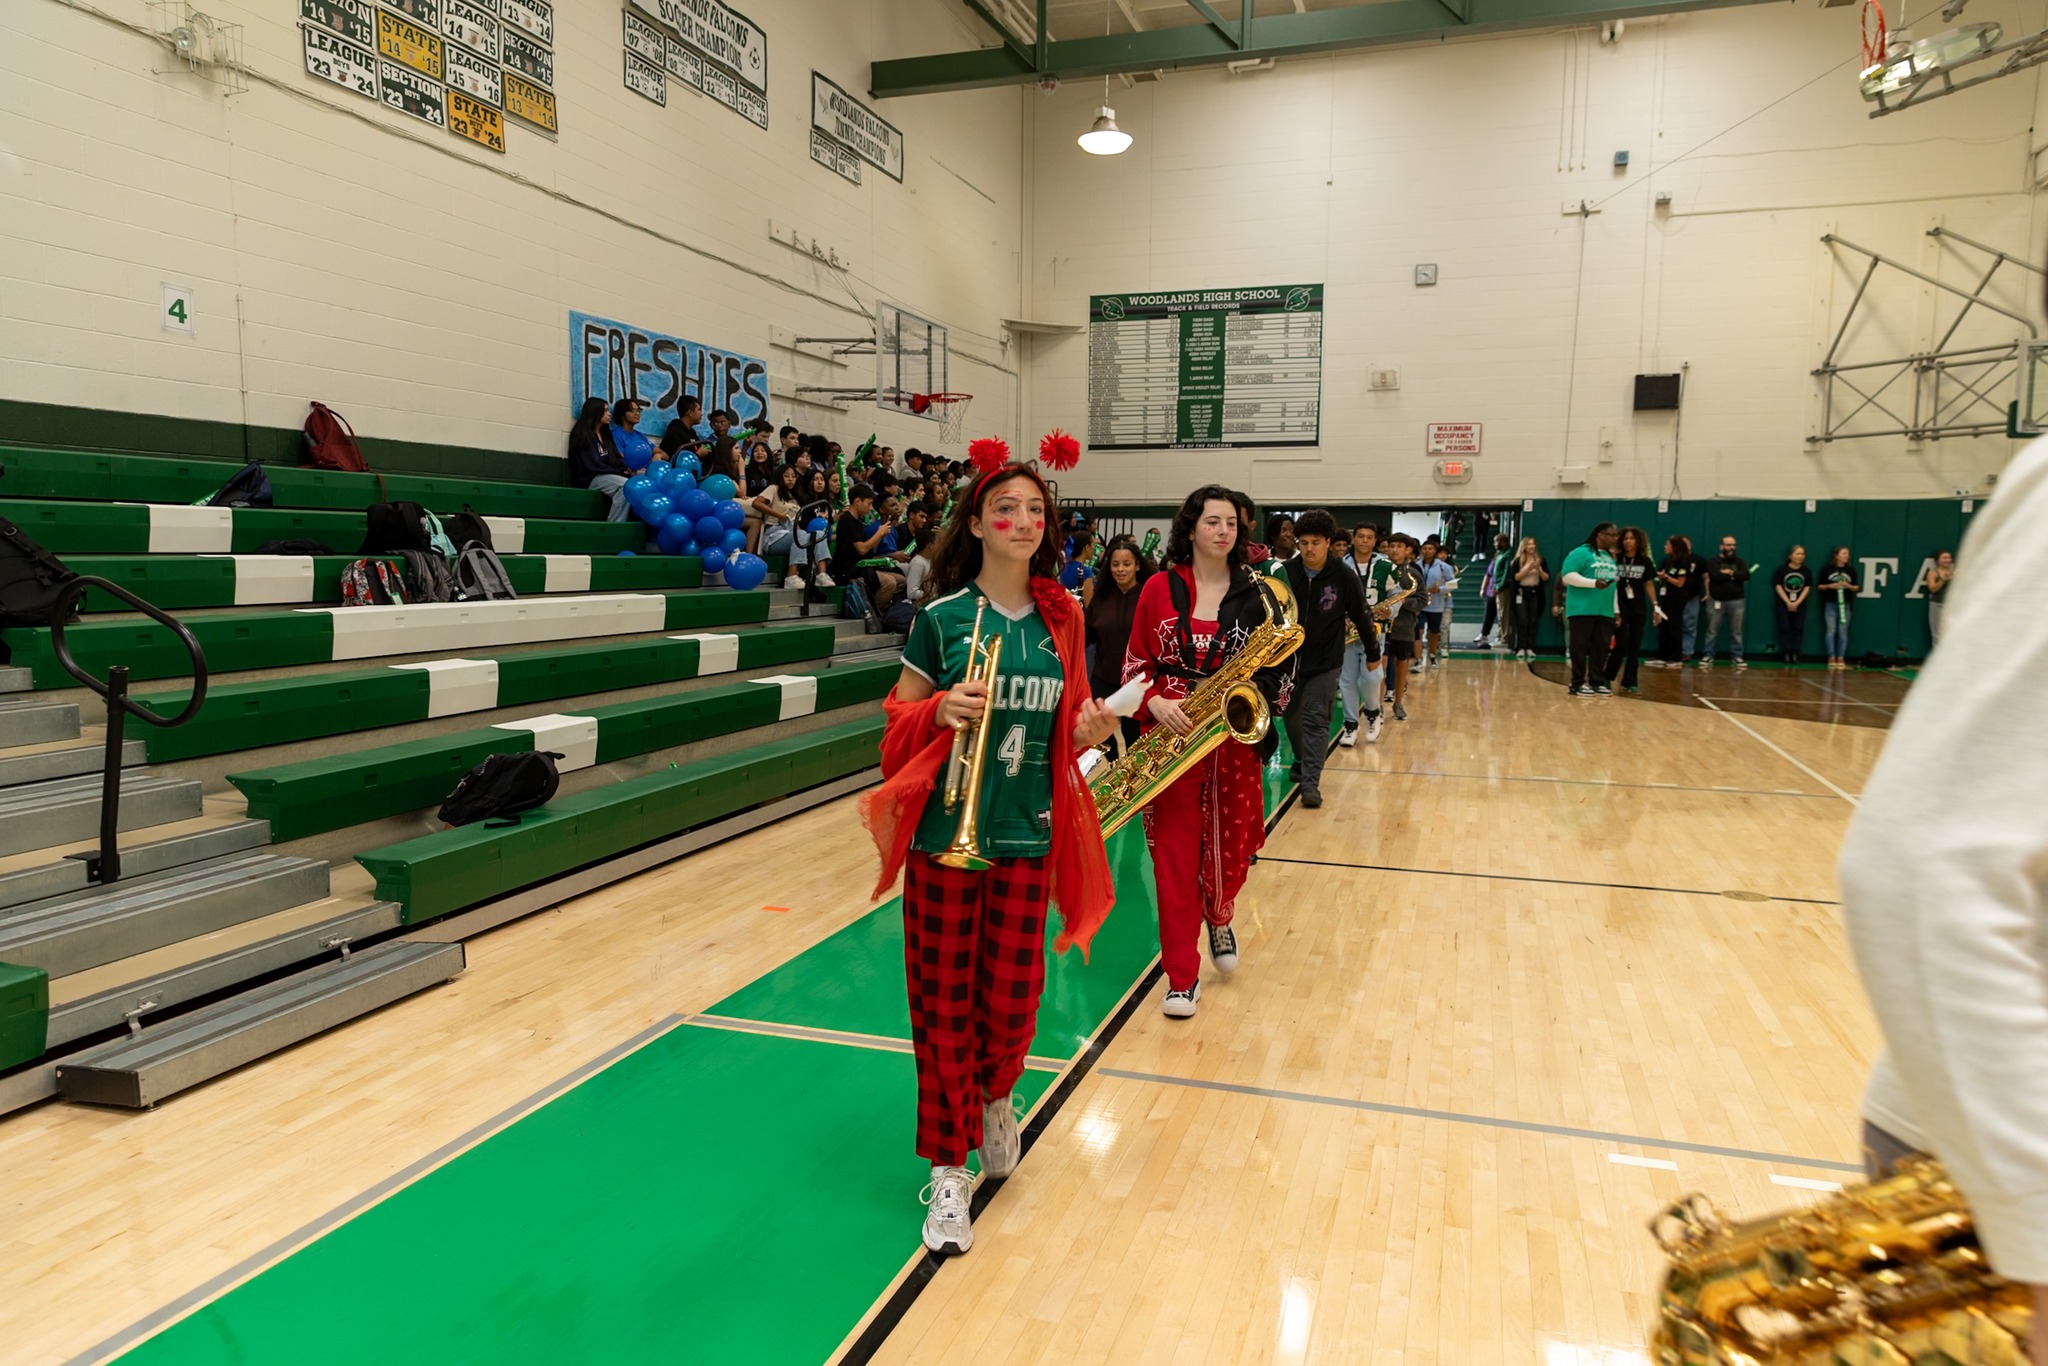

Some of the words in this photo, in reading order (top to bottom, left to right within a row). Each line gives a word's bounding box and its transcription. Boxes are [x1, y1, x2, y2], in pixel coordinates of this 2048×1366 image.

[419, 4, 436, 25] '14
[446, 0, 495, 39] LEAGUE
[505, 3, 519, 21] '13
[536, 21, 550, 39] '14
[659, 0, 693, 38] SOCER
[350, 21, 371, 43] '15
[382, 15, 438, 57] STATE
[445, 18, 463, 39] '14
[481, 36, 496, 56] '15
[627, 16, 662, 49] LEAGUE
[627, 31, 639, 47] '07
[306, 29, 374, 74] LEAGUE
[333, 58, 350, 70] BOYS
[383, 36, 400, 56] '14
[422, 55, 438, 74] '15
[504, 31, 551, 68] SECTION
[505, 49, 521, 68] '14
[537, 66, 552, 83] '15
[668, 41, 700, 72] LEAGUE
[308, 55, 331, 77] '23
[353, 74, 374, 95] '24
[382, 62, 442, 103] SECTION
[448, 48, 499, 86] LEAGUE
[628, 56, 663, 88] LEAGUE
[705, 64, 734, 93] LEAGUE
[404, 88, 420, 100] BOYS
[449, 68, 464, 87] '15
[484, 84, 499, 102] '16
[508, 77, 552, 112] STATE
[628, 72, 640, 88] '13
[652, 85, 663, 102] '14
[704, 79, 715, 94] '12
[739, 86, 766, 113] LEAGUE
[383, 86, 403, 108] '23
[422, 103, 442, 124] '24
[454, 95, 497, 128] STATE
[509, 97, 522, 113] '13
[539, 112, 554, 128] '14
[451, 115, 468, 134] '23
[485, 130, 502, 149] '24
[168, 298, 188, 324] 4
[1129, 293, 1200, 306] WOODLANDS
[1203, 291, 1231, 302] HIGH
[1235, 289, 1281, 301] SCHOOL
[1167, 304, 1186, 312] TRACK
[1194, 303, 1210, 311] FIELD
[1211, 302, 1240, 310] RECORDS
[584, 323, 767, 429] FRESHIES
[997, 724, 1026, 777] 4
